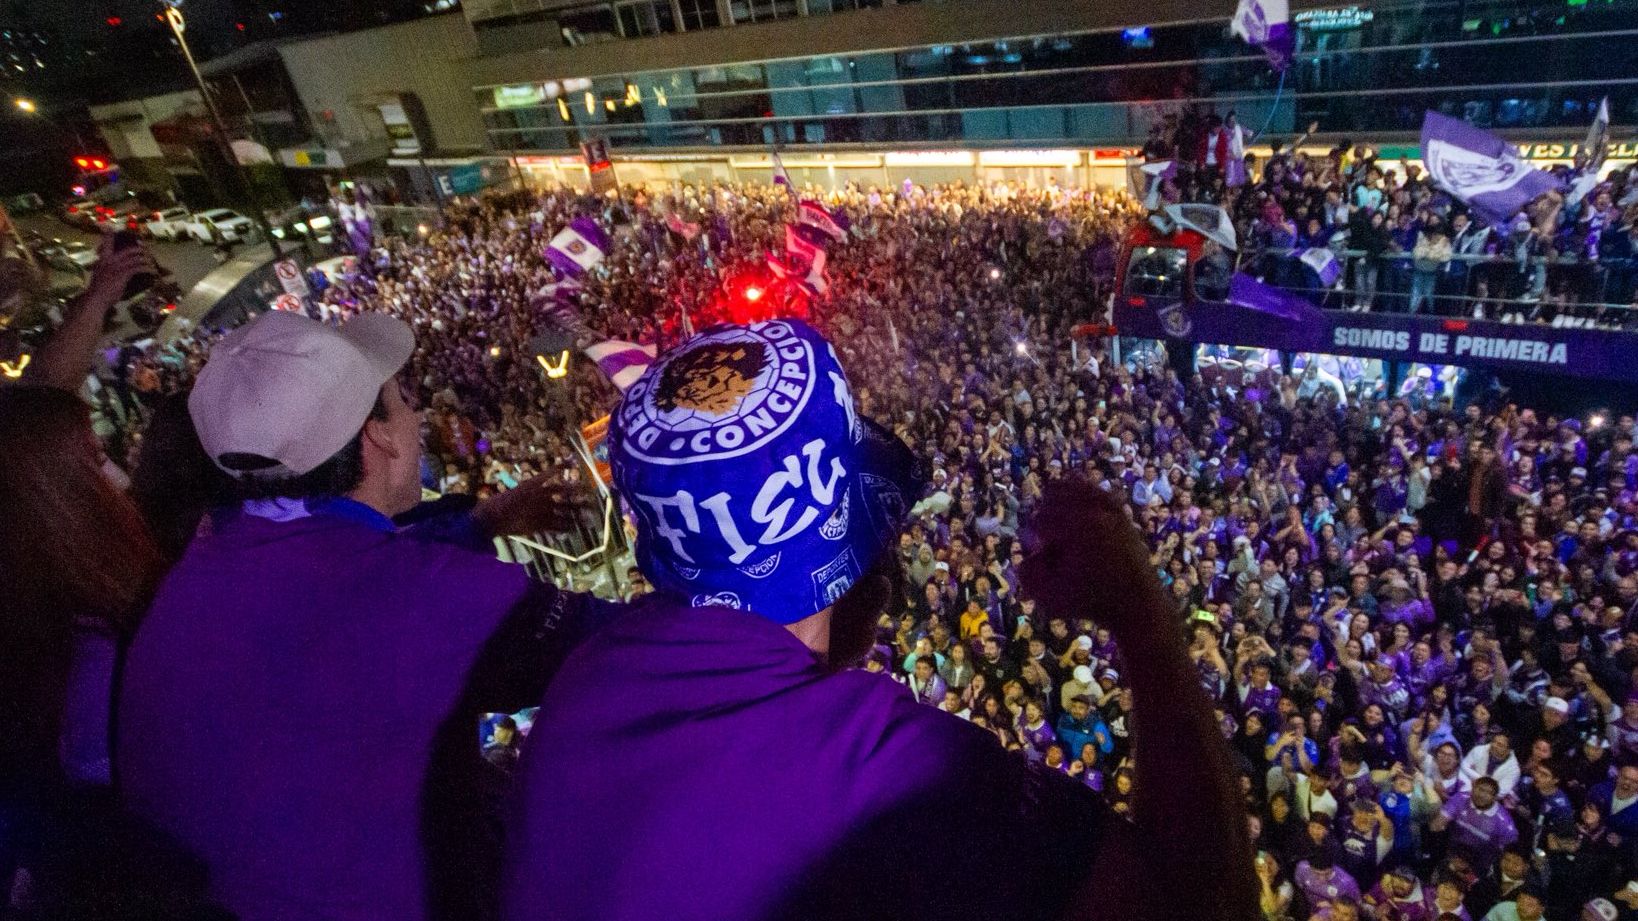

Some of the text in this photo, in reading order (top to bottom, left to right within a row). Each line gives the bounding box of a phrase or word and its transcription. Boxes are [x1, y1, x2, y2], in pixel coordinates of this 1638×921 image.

[1333, 326, 1568, 364] SOMOS DE PRIMERA
[624, 381, 662, 451] DEPO
